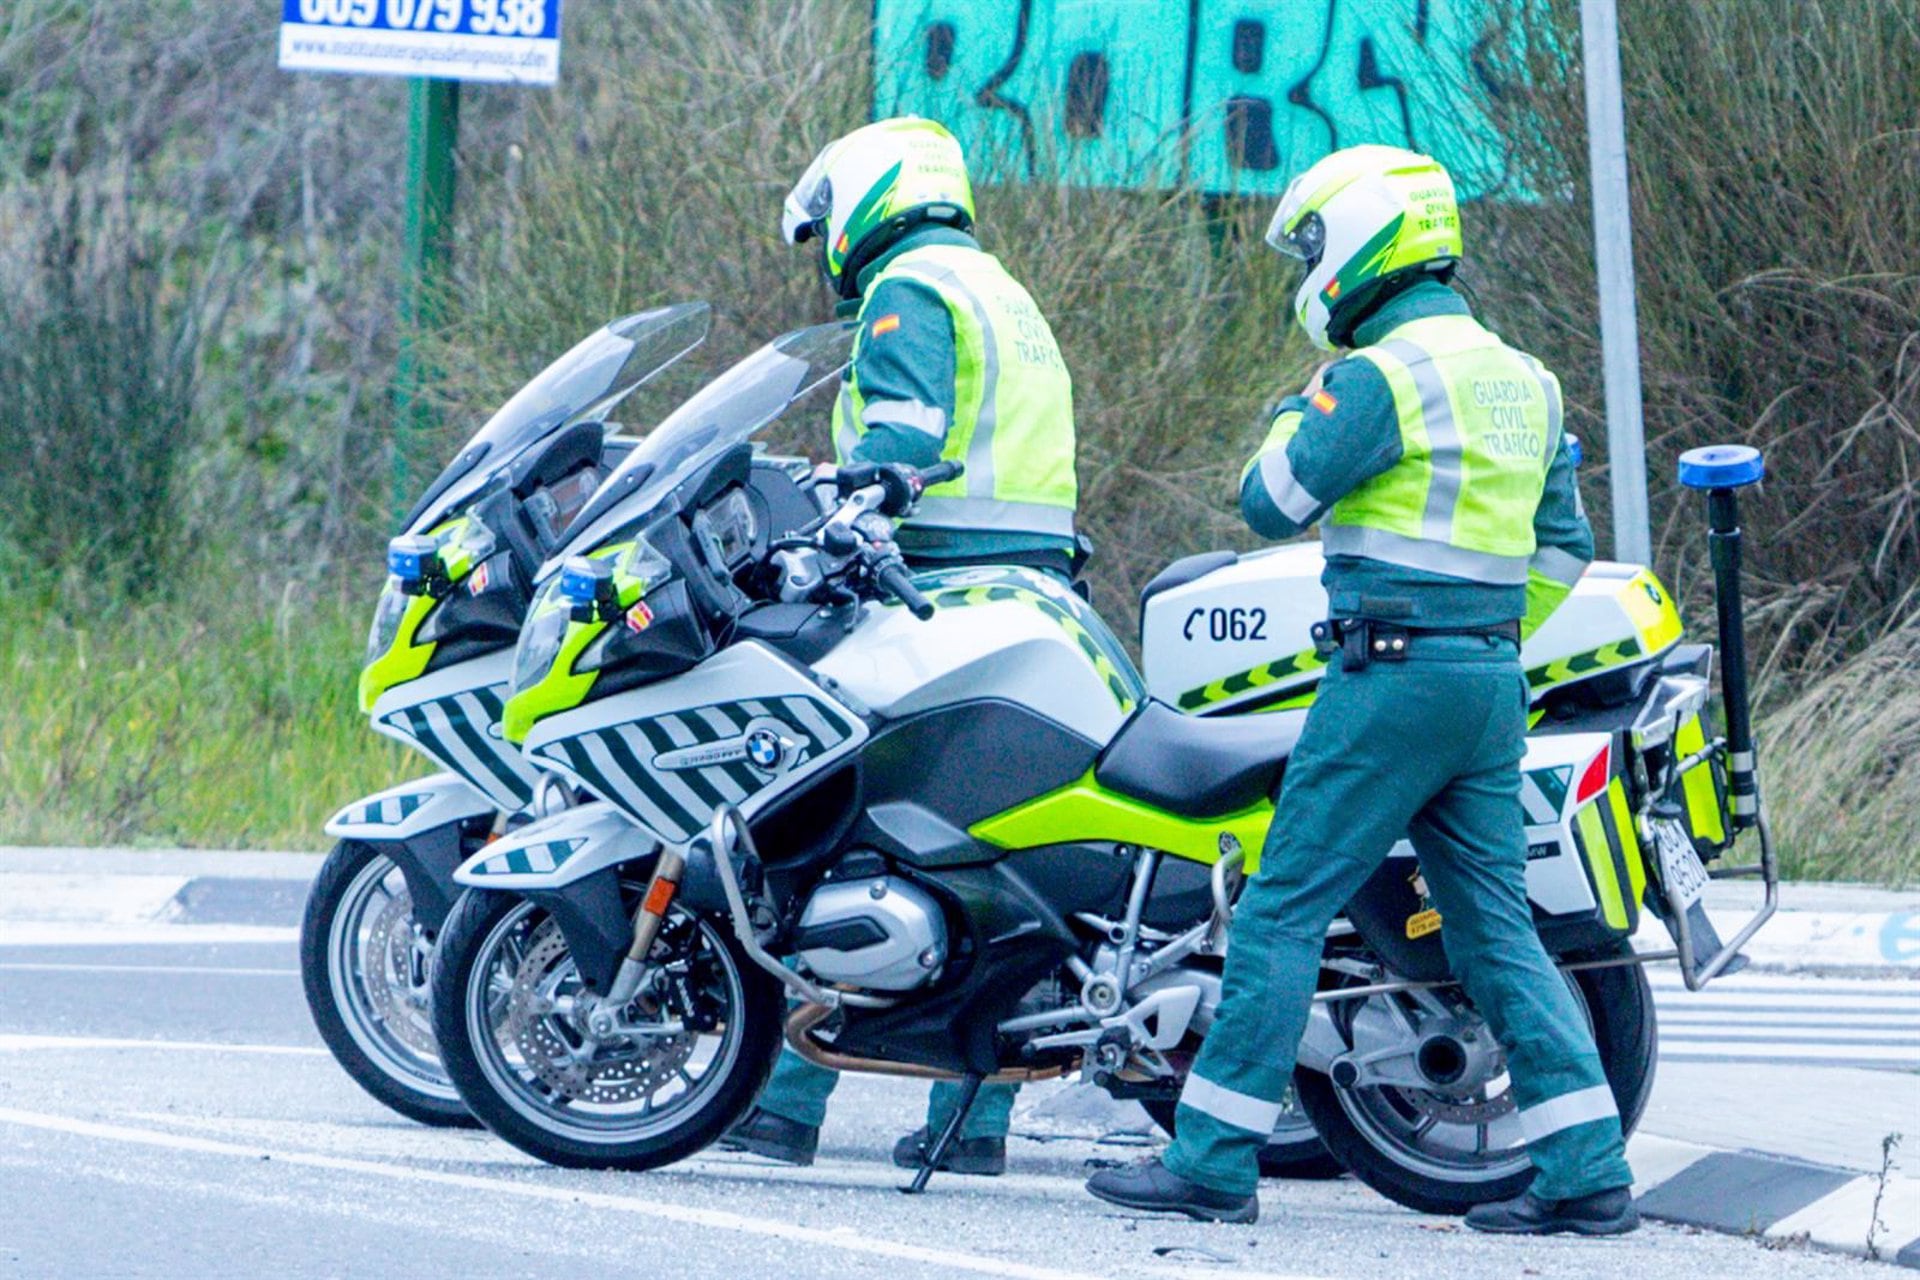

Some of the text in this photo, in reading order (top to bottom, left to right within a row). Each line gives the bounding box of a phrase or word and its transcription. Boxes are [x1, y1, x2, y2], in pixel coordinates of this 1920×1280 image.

[385, 0, 463, 31] 079
[469, 0, 546, 36] 938
[1473, 378, 1533, 405] GUARDIA
[1491, 405, 1528, 430] CIVIL
[1482, 431, 1540, 458] TRAFICO
[1209, 607, 1267, 642] 062
